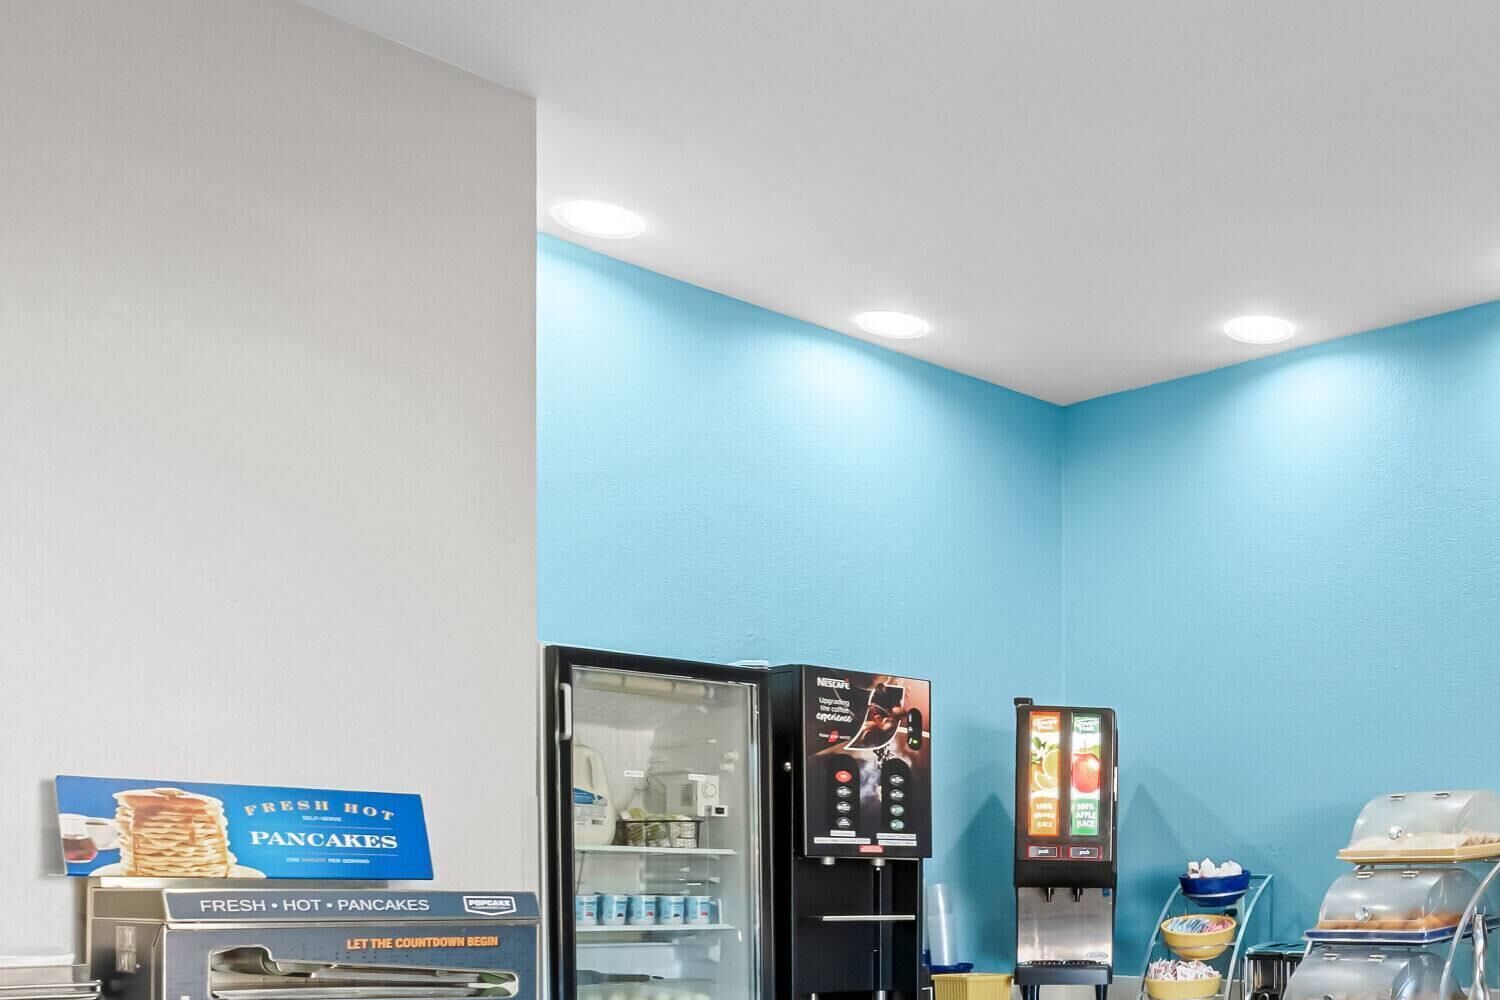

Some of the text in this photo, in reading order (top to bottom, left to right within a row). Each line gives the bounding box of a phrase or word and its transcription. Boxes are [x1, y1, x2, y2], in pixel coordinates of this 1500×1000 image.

[819, 697, 850, 708] Upgrading
[831, 706, 849, 714] coffee
[244, 800, 394, 821] FRESH HOT
[1076, 811, 1096, 819] APPLE
[1076, 820, 1095, 828] JUICE
[249, 831, 398, 849] PANCAKES
[200, 899, 430, 912] FRESH HOT PANCAKES
[347, 936, 499, 950] LET THE COUNTDOWN BEGIN
